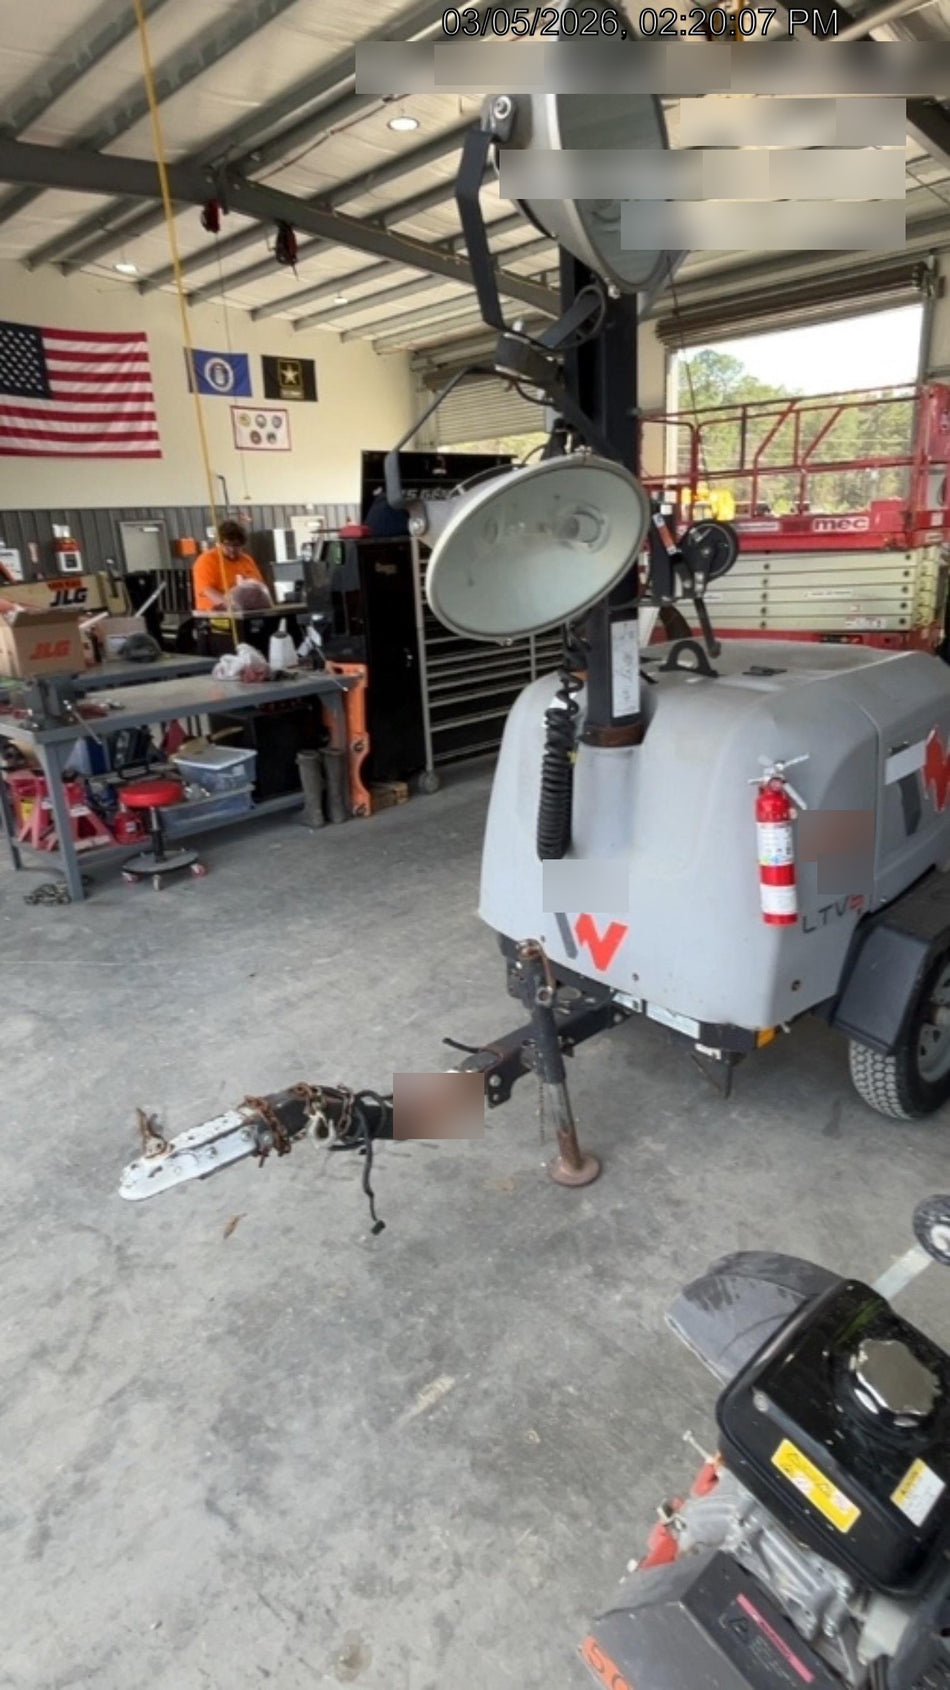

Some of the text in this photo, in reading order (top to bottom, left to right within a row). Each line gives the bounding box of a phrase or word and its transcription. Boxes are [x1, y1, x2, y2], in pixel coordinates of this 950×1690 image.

[815, 518, 867, 530] mec
[50, 587, 88, 606] JLG
[29, 640, 71, 660] JLG
